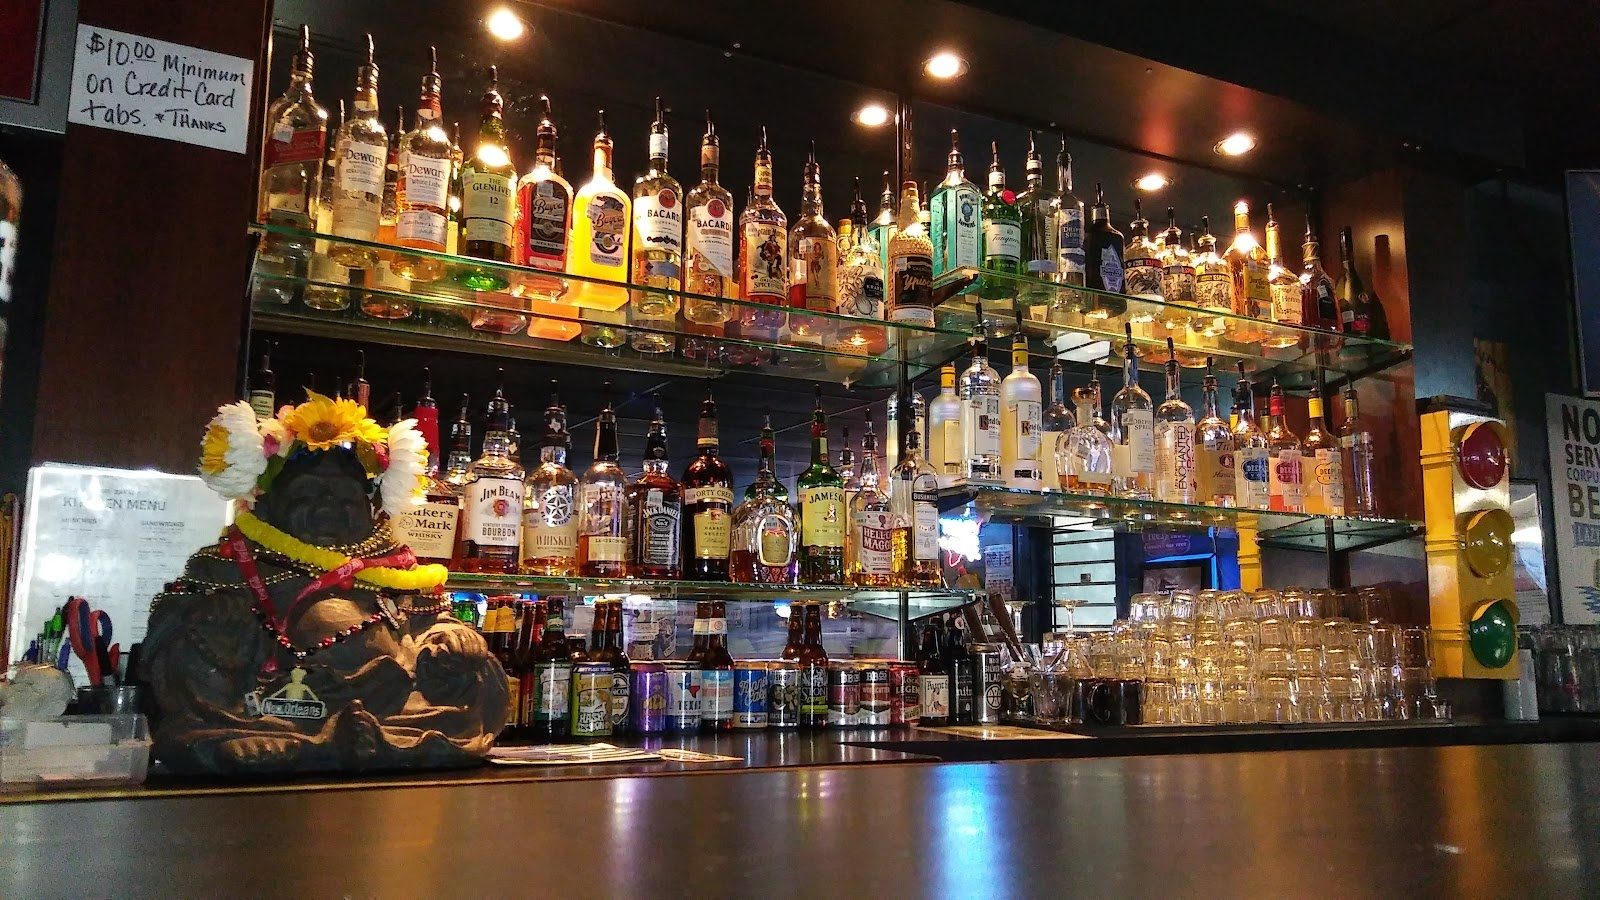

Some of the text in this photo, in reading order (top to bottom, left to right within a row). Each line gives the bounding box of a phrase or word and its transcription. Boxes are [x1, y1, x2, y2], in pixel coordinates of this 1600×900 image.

[163, 54, 246, 86] Minimum
[125, 70, 192, 99] Credit
[195, 81, 236, 108] Card
[488, 177, 501, 185] THE
[489, 196, 499, 205] 12
[647, 209, 681, 223] BACARD
[480, 488, 498, 503] JIM
[696, 489, 714, 497] ORTY
[809, 490, 843, 505] JAMESO
[126, 499, 167, 511] MENU
[414, 519, 453, 531] Mark
[482, 527, 516, 537] BOURBON
[863, 537, 890, 551] MAGG
[895, 685, 920, 694] LEGEN
[265, 701, 321, 717] New Orleans
